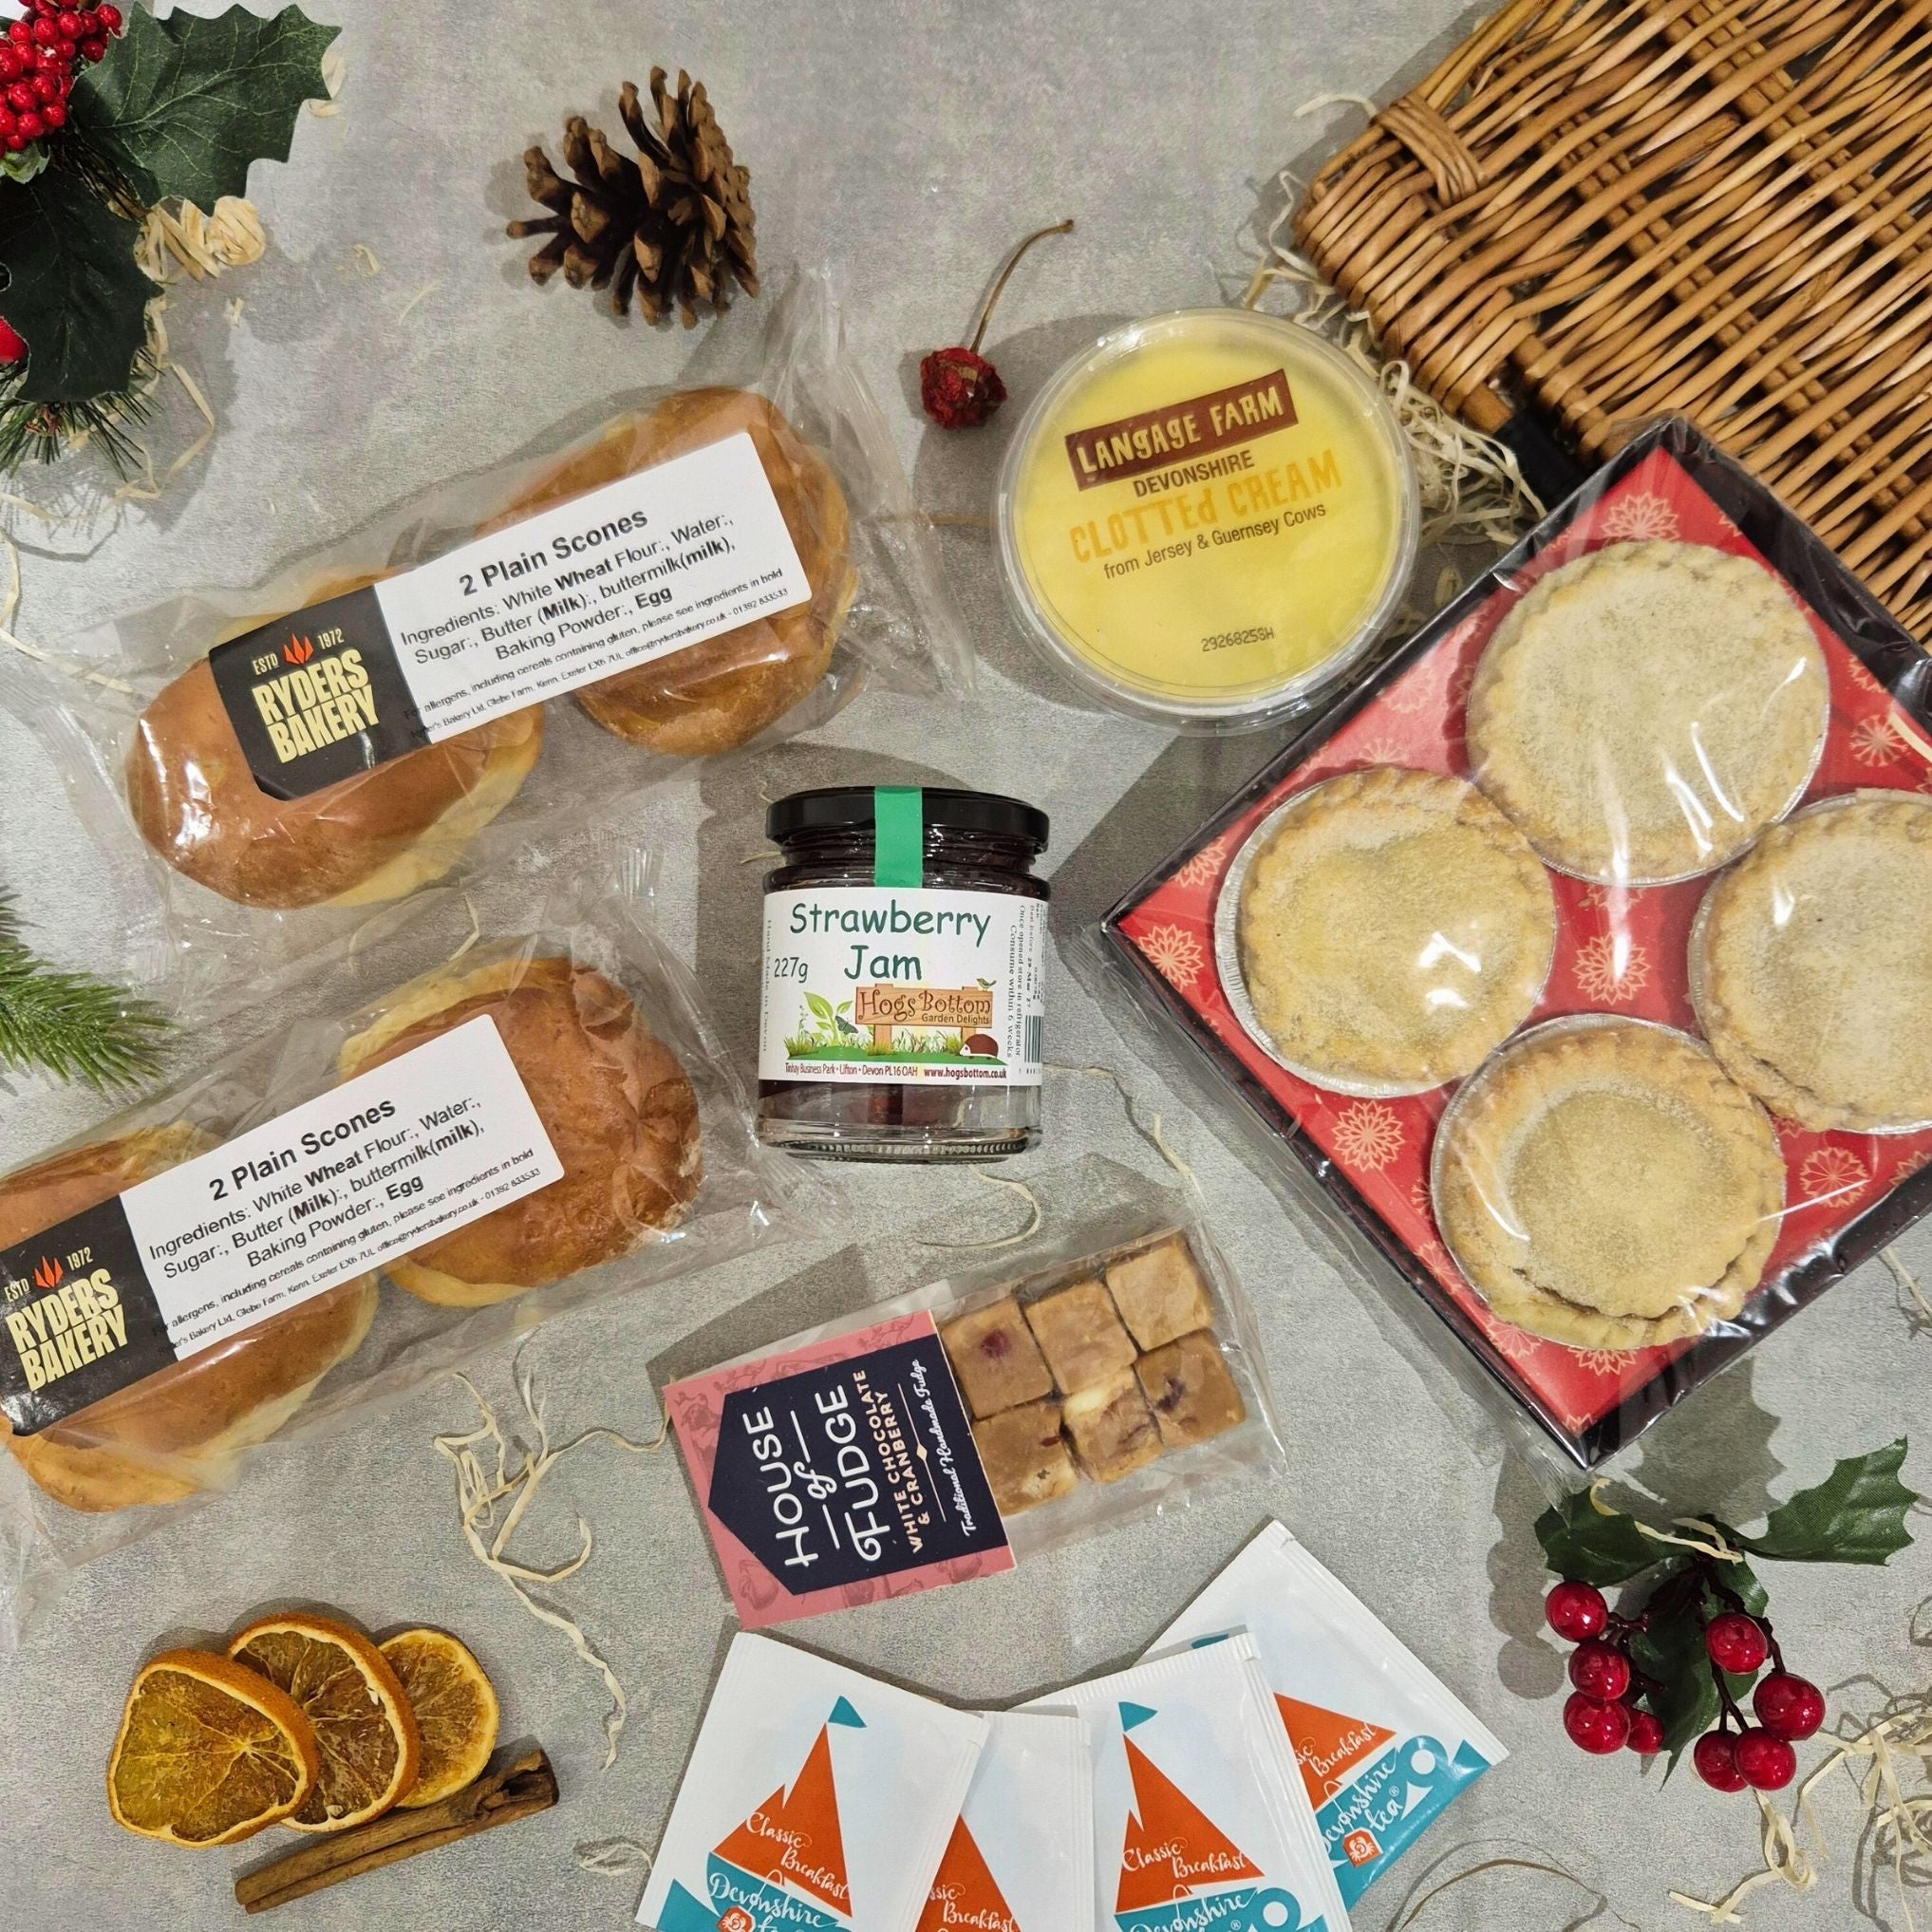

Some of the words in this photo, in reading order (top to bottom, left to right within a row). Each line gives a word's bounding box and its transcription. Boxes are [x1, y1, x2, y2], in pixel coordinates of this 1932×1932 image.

[1210, 385, 1284, 437] FARM
[1133, 450, 1254, 497] DEVONSHIRE
[1227, 449, 1342, 517] CREAM
[460, 574, 478, 596] 2
[480, 552, 548, 587] Plain
[553, 511, 647, 559] Scones
[1103, 558, 1140, 579] from
[1145, 540, 1191, 566] Jersey
[1196, 535, 1210, 550] &
[1211, 518, 1279, 545] Guernsey
[1284, 504, 1326, 527] Cows
[401, 607, 499, 646] Ingredients:
[502, 585, 553, 610] White
[554, 558, 613, 591] Wheat
[495, 631, 555, 660] Baking
[634, 588, 672, 609] Egg
[733, 600, 757, 615] 01392
[759, 588, 788, 605] 833533
[253, 653, 279, 675] ESTD
[317, 628, 345, 649] 1972
[471, 671, 516, 691] including
[516, 658, 553, 675] cereals
[555, 639, 605, 662] containing
[642, 613, 673, 631] please
[675, 606, 694, 616] see
[695, 584, 748, 609] ingredients
[760, 568, 782, 584] bold
[480, 615, 532, 642] Butter
[252, 648, 371, 725] RYDERS
[266, 685, 380, 763] BAKERY
[790, 899, 991, 947] Strawberry
[1016, 930, 1024, 965] opened
[774, 957, 808, 984] 227g
[844, 945, 922, 981] Jam
[1008, 924, 1018, 975] Consume
[857, 988, 916, 1022] Hogs
[918, 989, 991, 1014] Bottom
[921, 1013, 954, 1022] Garden
[957, 1014, 990, 1025] Delights
[1006, 978, 1015, 1011] within
[1016, 991, 1022, 1001] in
[1005, 1024, 1014, 1059] weeks
[1013, 1003, 1023, 1057] refrigerator
[862, 1064, 884, 1076] Devon
[924, 1066, 1006, 1080] www.hogsbottom.co.uk
[209, 1178, 228, 1201] 2
[231, 1149, 297, 1191] Plain
[301, 1100, 395, 1155] Scones
[149, 1208, 251, 1260] Ingredients:
[253, 1183, 303, 1212] White
[304, 1151, 364, 1187] Wheat
[485, 1183, 510, 1199] 01392
[511, 1168, 540, 1187] 833533
[172, 1301, 219, 1327] allergens,
[221, 1279, 267, 1303] including
[269, 1261, 304, 1282] cereals
[306, 1235, 356, 1264] containing
[358, 1221, 391, 1240] gluten,
[393, 1203, 425, 1224] please
[427, 1193, 446, 1206] see
[447, 1167, 499, 1196] ingredients
[501, 1161, 511, 1170] in
[511, 1148, 534, 1165] bold
[232, 1216, 283, 1248] Butter
[247, 1232, 307, 1267] Baking
[385, 1176, 423, 1200] Egg
[66, 1247, 93, 1270] 1972
[6, 1268, 119, 1354] RYDERS
[20, 1304, 128, 1392] BAKERY
[910, 1360, 930, 1397] Fudge
[853, 1370, 900, 1484] CHOCOLATE
[874, 1392, 923, 1505] CRANBERRY
[921, 1397, 953, 1467] Handmade
[742, 1406, 818, 1566] HOUSE
[794, 1456, 837, 1499] of
[815, 1385, 891, 1560] FUDGE
[893, 1490, 923, 1553] WHITE
[918, 1511, 930, 1525] &
[943, 1467, 976, 1536] Traditional
[1309, 1722, 1377, 1777] Breakfast
[746, 1812, 812, 1848] Classic
[1122, 1836, 1189, 1871] Classic
[780, 1846, 849, 1899] Breakfast
[1172, 1850, 1247, 1879] Breakfast
[709, 1872, 838, 1928] Devonshire
[929, 1883, 966, 1901] ssic
[943, 1900, 1014, 1932] Breakfast
